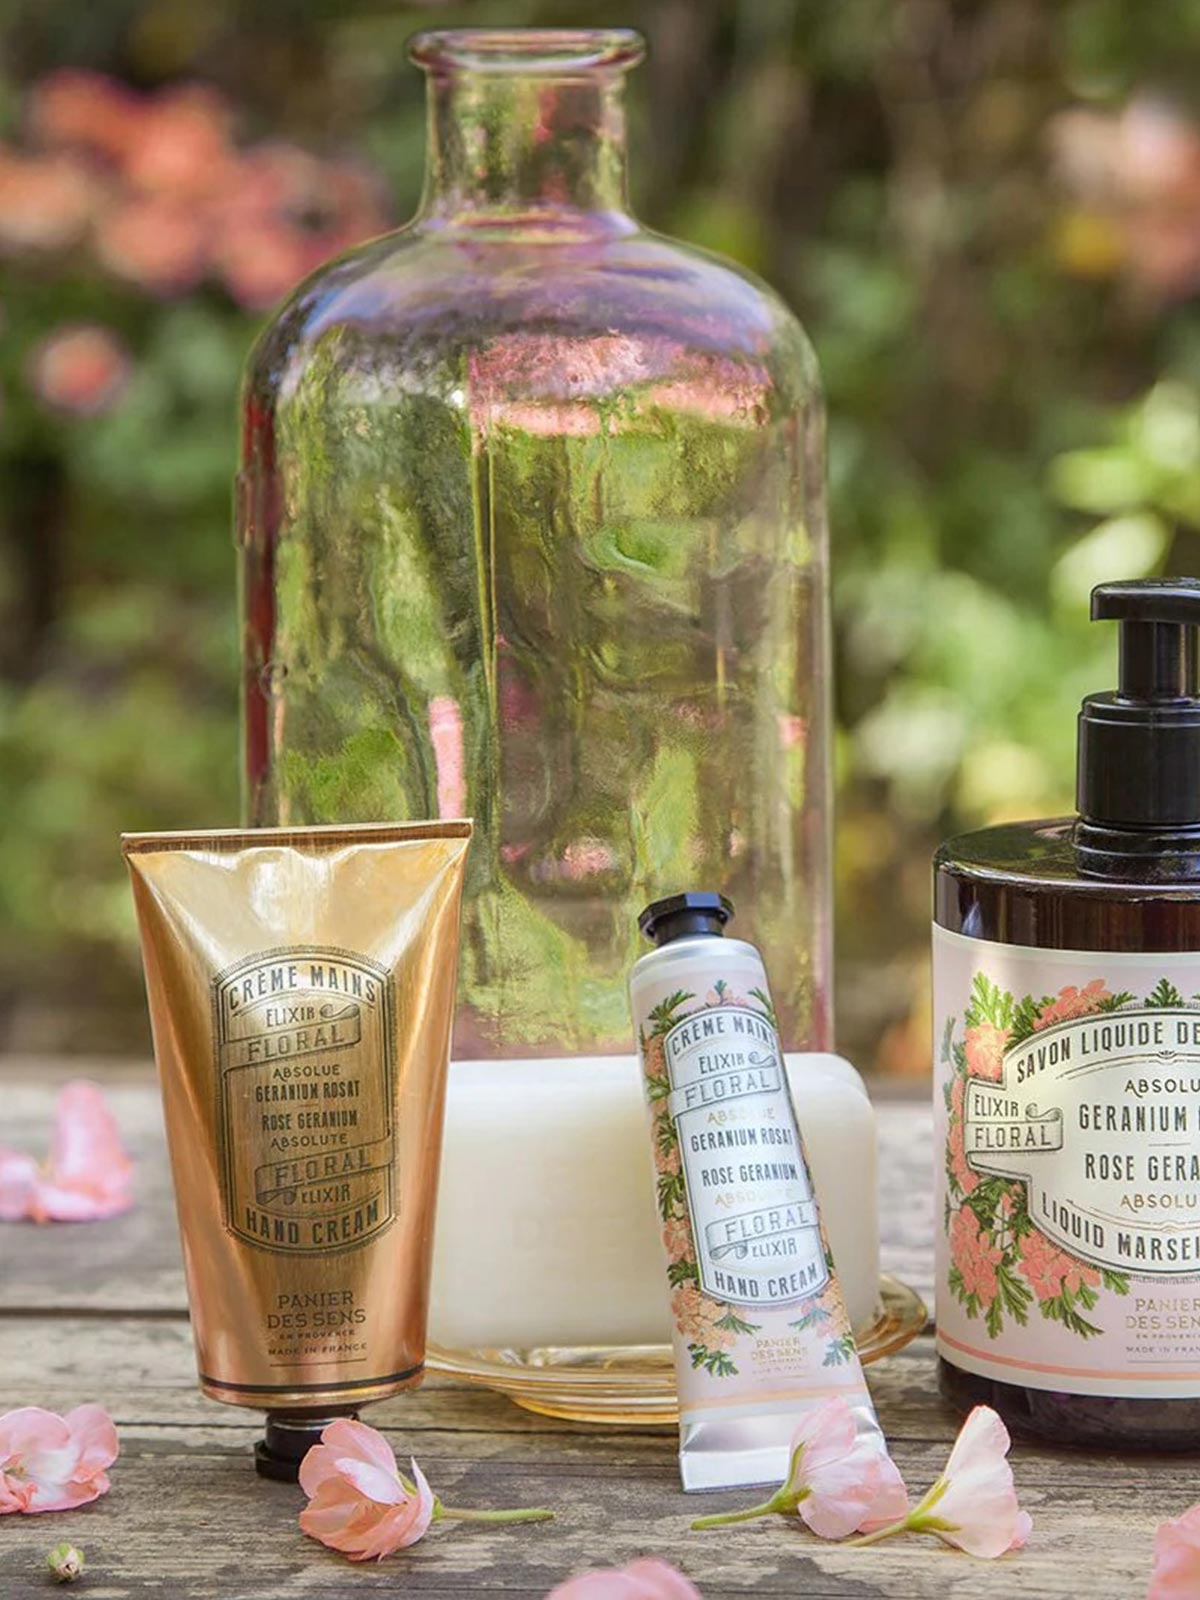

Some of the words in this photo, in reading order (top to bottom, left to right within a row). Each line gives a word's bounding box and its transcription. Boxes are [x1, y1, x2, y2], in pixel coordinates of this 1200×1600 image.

[229, 966, 297, 1010] CRÈME
[310, 965, 376, 1002] MAINS
[266, 1007, 315, 1027] ELIXIR
[248, 1024, 344, 1062] FLORAL
[672, 1016, 725, 1056] CRÈME
[1017, 1037, 1071, 1083] SAVON
[1081, 1021, 1163, 1055] LIQUIDE
[1177, 1020, 1200, 1045] DE
[273, 1064, 340, 1082] ABSOLUE
[698, 1053, 745, 1074] ELIXIR
[255, 1082, 318, 1102] GERANIUM
[323, 1080, 360, 1098] ROSAT
[684, 1070, 770, 1107] FLORAL
[974, 1094, 1019, 1117] ELIXIR
[262, 1113, 291, 1131] ROSE
[297, 1110, 358, 1128] GERANIUM
[1079, 1103, 1187, 1132] GERANIUM
[271, 1134, 348, 1151] ABSOLUTE
[691, 1128, 758, 1152] GERANIUM
[761, 1128, 793, 1145] ROSAT
[975, 1125, 1052, 1148] FLORAL
[275, 1148, 372, 1187] FLORAL
[701, 1166, 735, 1187] ROSE
[740, 1164, 798, 1183] GERANIUM
[1086, 1153, 1134, 1181] ROSE
[1148, 1155, 1200, 1181] GERA
[301, 1184, 351, 1204] ELIXIR
[1120, 1194, 1197, 1213] ABSOLU
[245, 1207, 299, 1244] HAND
[312, 1200, 379, 1244] CREAM
[724, 1210, 809, 1242] FLORAL
[1042, 1192, 1105, 1248] LIQUID
[752, 1238, 798, 1258] ELIXIR
[714, 1271, 760, 1298] HAND
[768, 1263, 818, 1297] CREAM
[278, 1290, 354, 1309] PANIER
[1135, 1298, 1200, 1312] PANIER
[267, 1314, 307, 1329] DES
[313, 1309, 366, 1327] SENS
[1125, 1316, 1161, 1329] DES
[1166, 1316, 1200, 1329] SEN
[304, 1346, 317, 1354] IN
[321, 1343, 367, 1353] FRANCE
